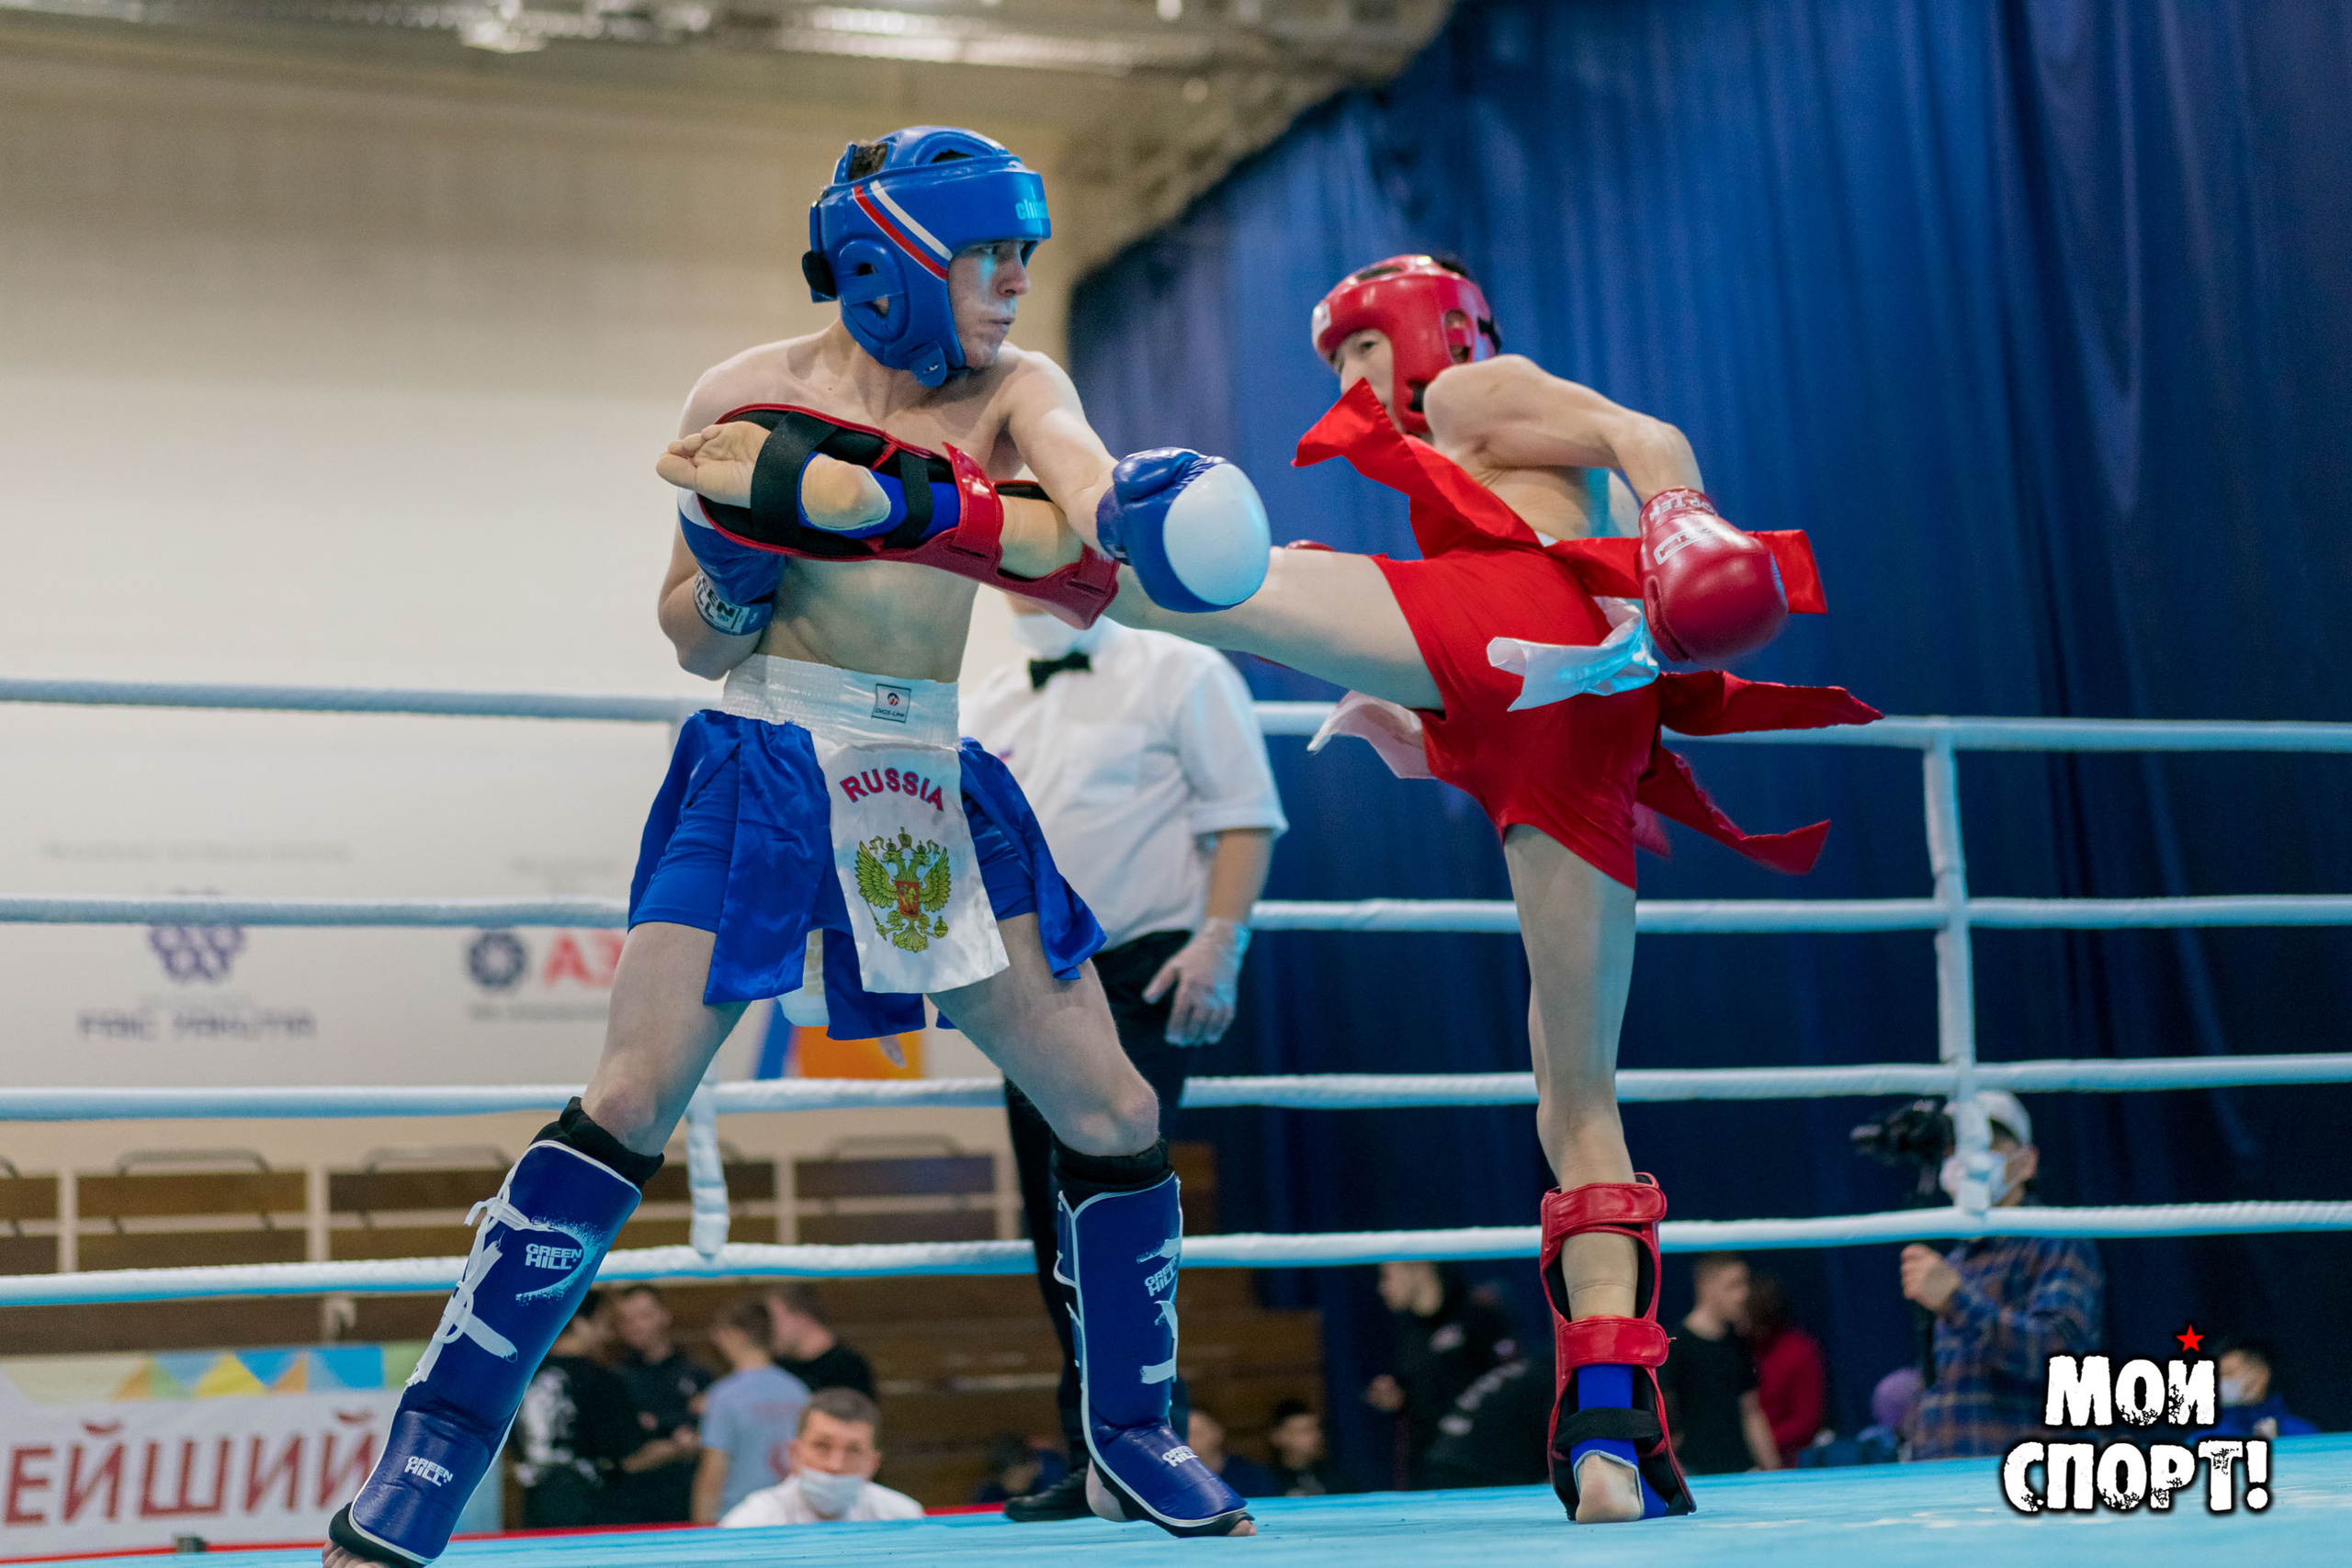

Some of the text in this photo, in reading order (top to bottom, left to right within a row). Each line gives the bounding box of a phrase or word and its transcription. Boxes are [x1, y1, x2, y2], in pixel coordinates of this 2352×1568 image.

[840, 767, 944, 811] RUSSIA
[525, 1253, 572, 1270] HILL
[526, 1243, 583, 1258] GREEN
[1148, 1268, 1177, 1297] HILL
[404, 1462, 442, 1487] HILL
[407, 1456, 454, 1483] GREEN
